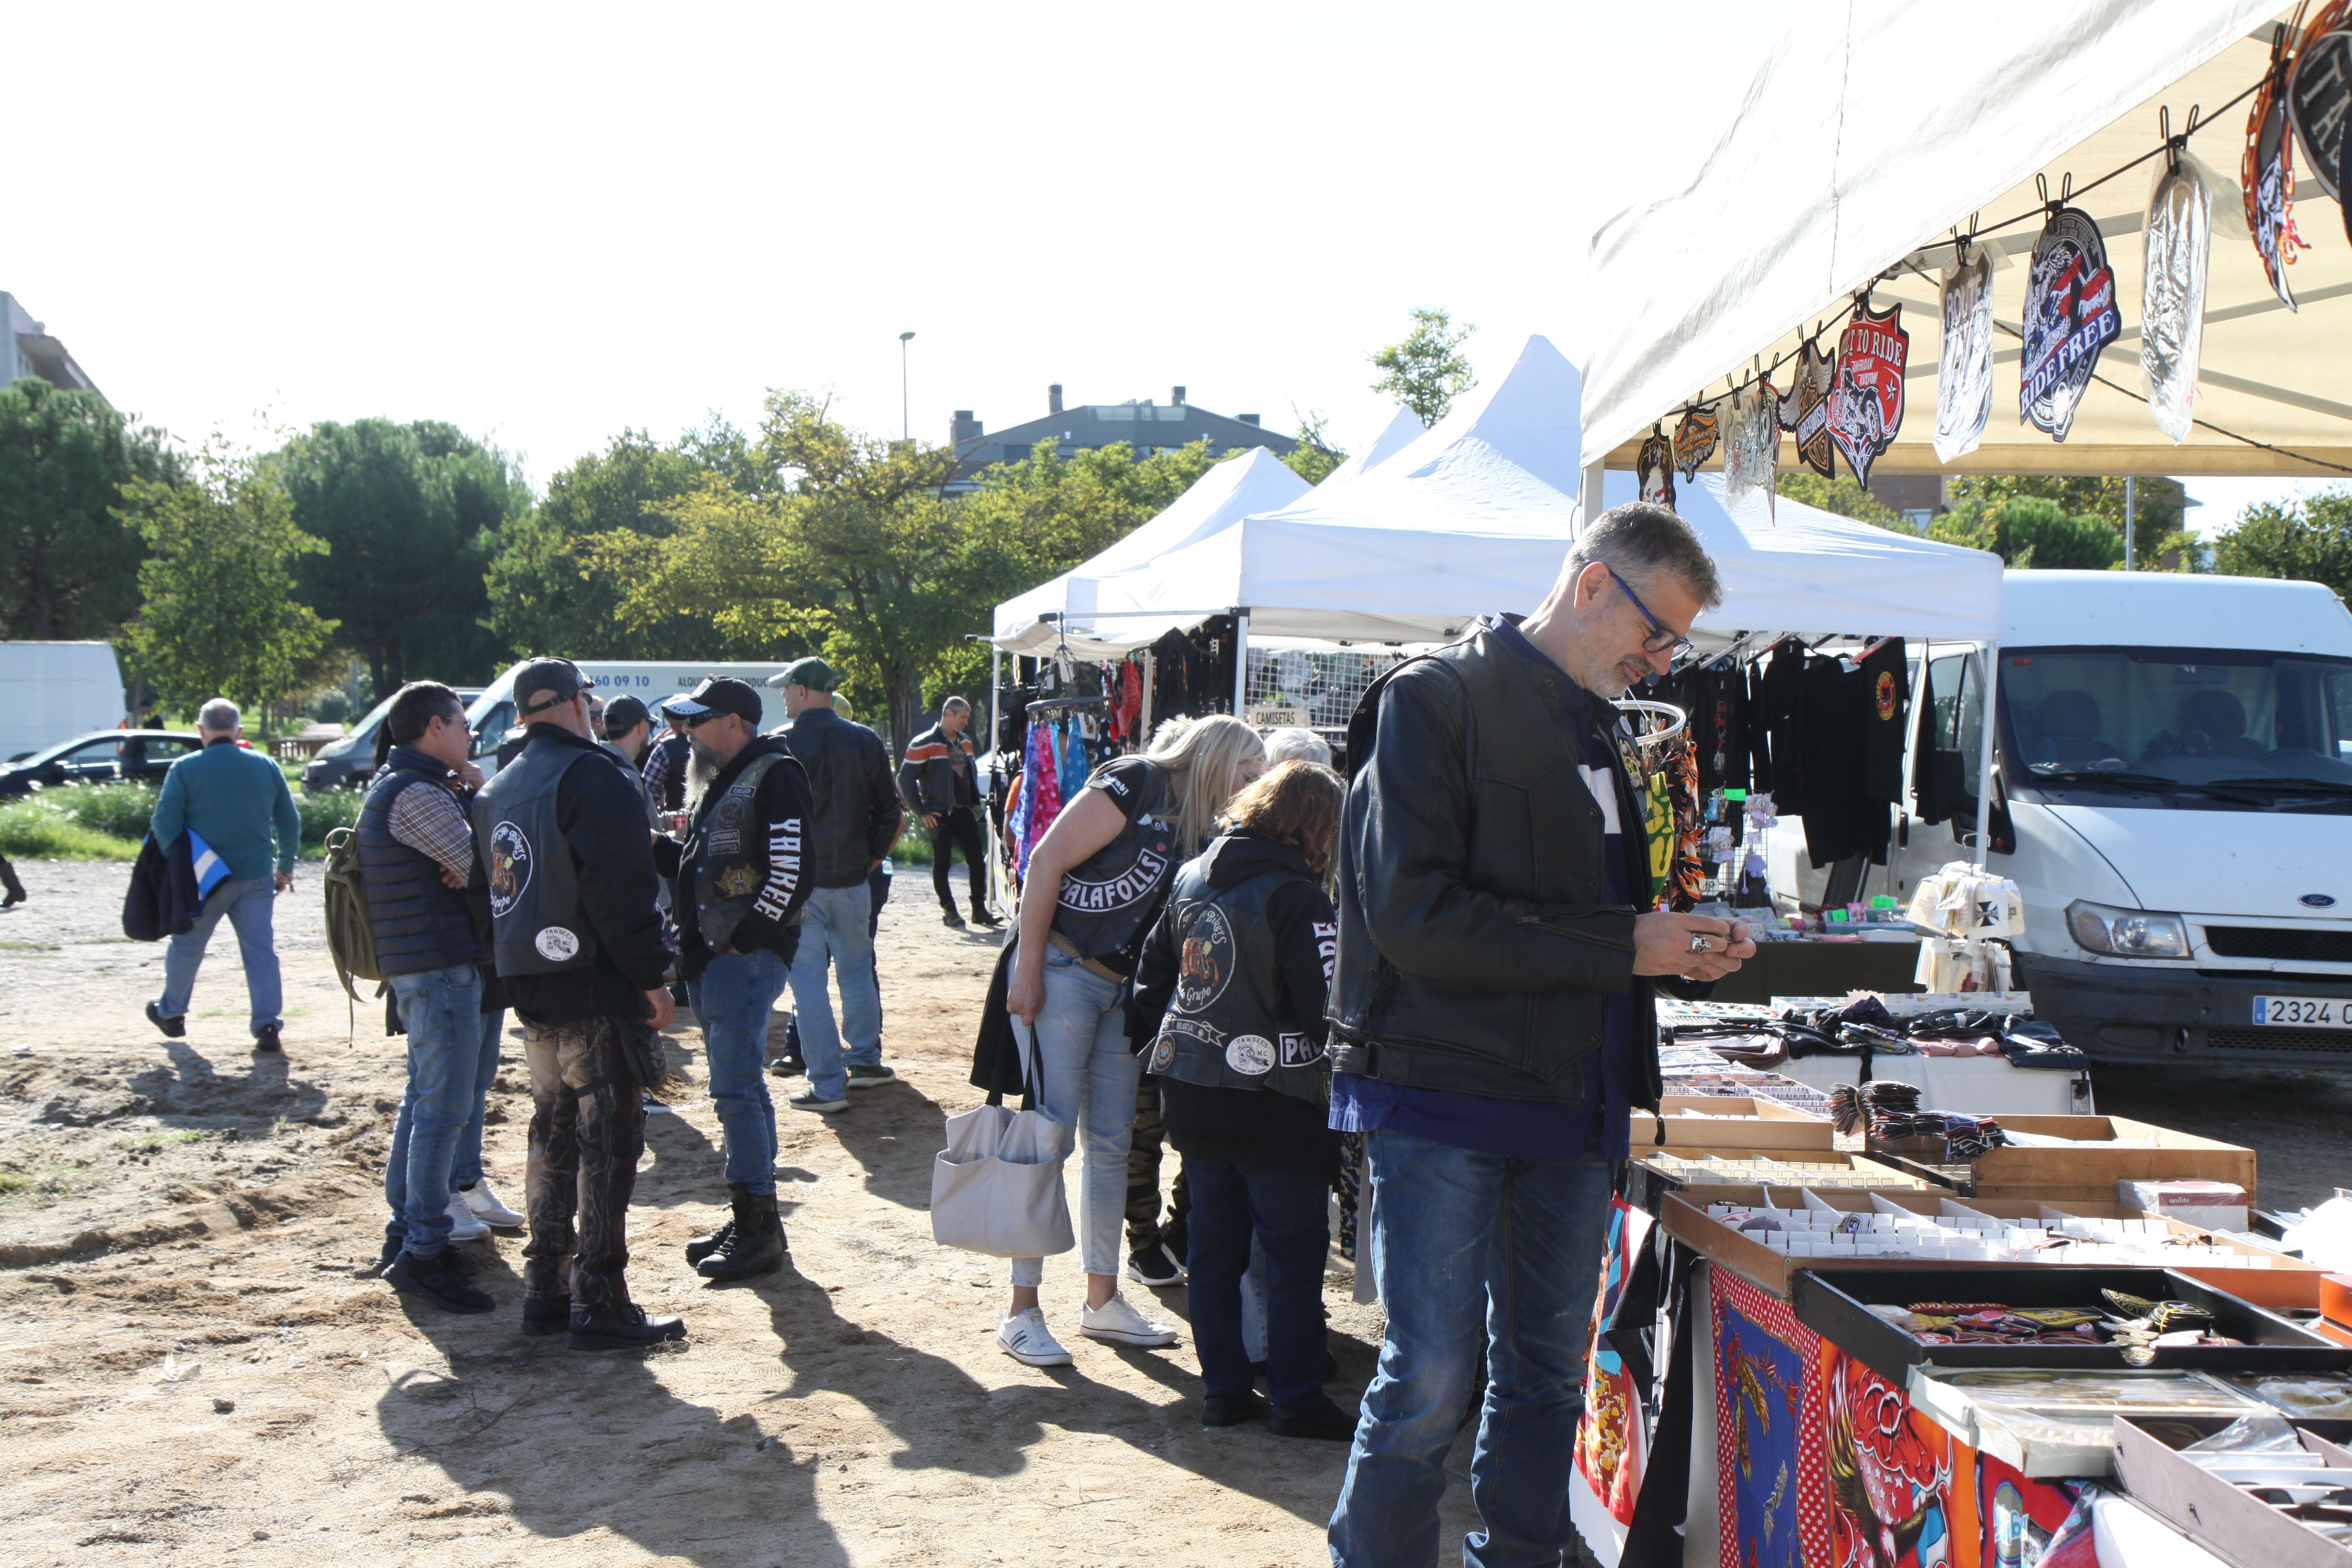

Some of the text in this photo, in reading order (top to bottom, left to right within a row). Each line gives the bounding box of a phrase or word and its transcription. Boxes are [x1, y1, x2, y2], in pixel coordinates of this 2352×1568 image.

[1946, 272, 1982, 328] ROUTE
[1857, 329, 1869, 353] TO
[1871, 331, 1903, 367] RIDE
[2021, 310, 2116, 416] RIDE FREE
[614, 675, 630, 687] 09
[636, 675, 649, 687] 10
[1256, 711, 1295, 725] CAMISETAS
[753, 818, 801, 922] YANKEE
[1060, 855, 1162, 909] PALAFOLLS
[2308, 896, 2328, 905] Ford
[545, 928, 575, 941] PAWNEES
[1186, 986, 1211, 1007] Grupo
[2271, 1000, 2331, 1024] 2324
[1176, 1021, 1194, 1033] MARIA
[1236, 1035, 1269, 1048] PAWNEES
